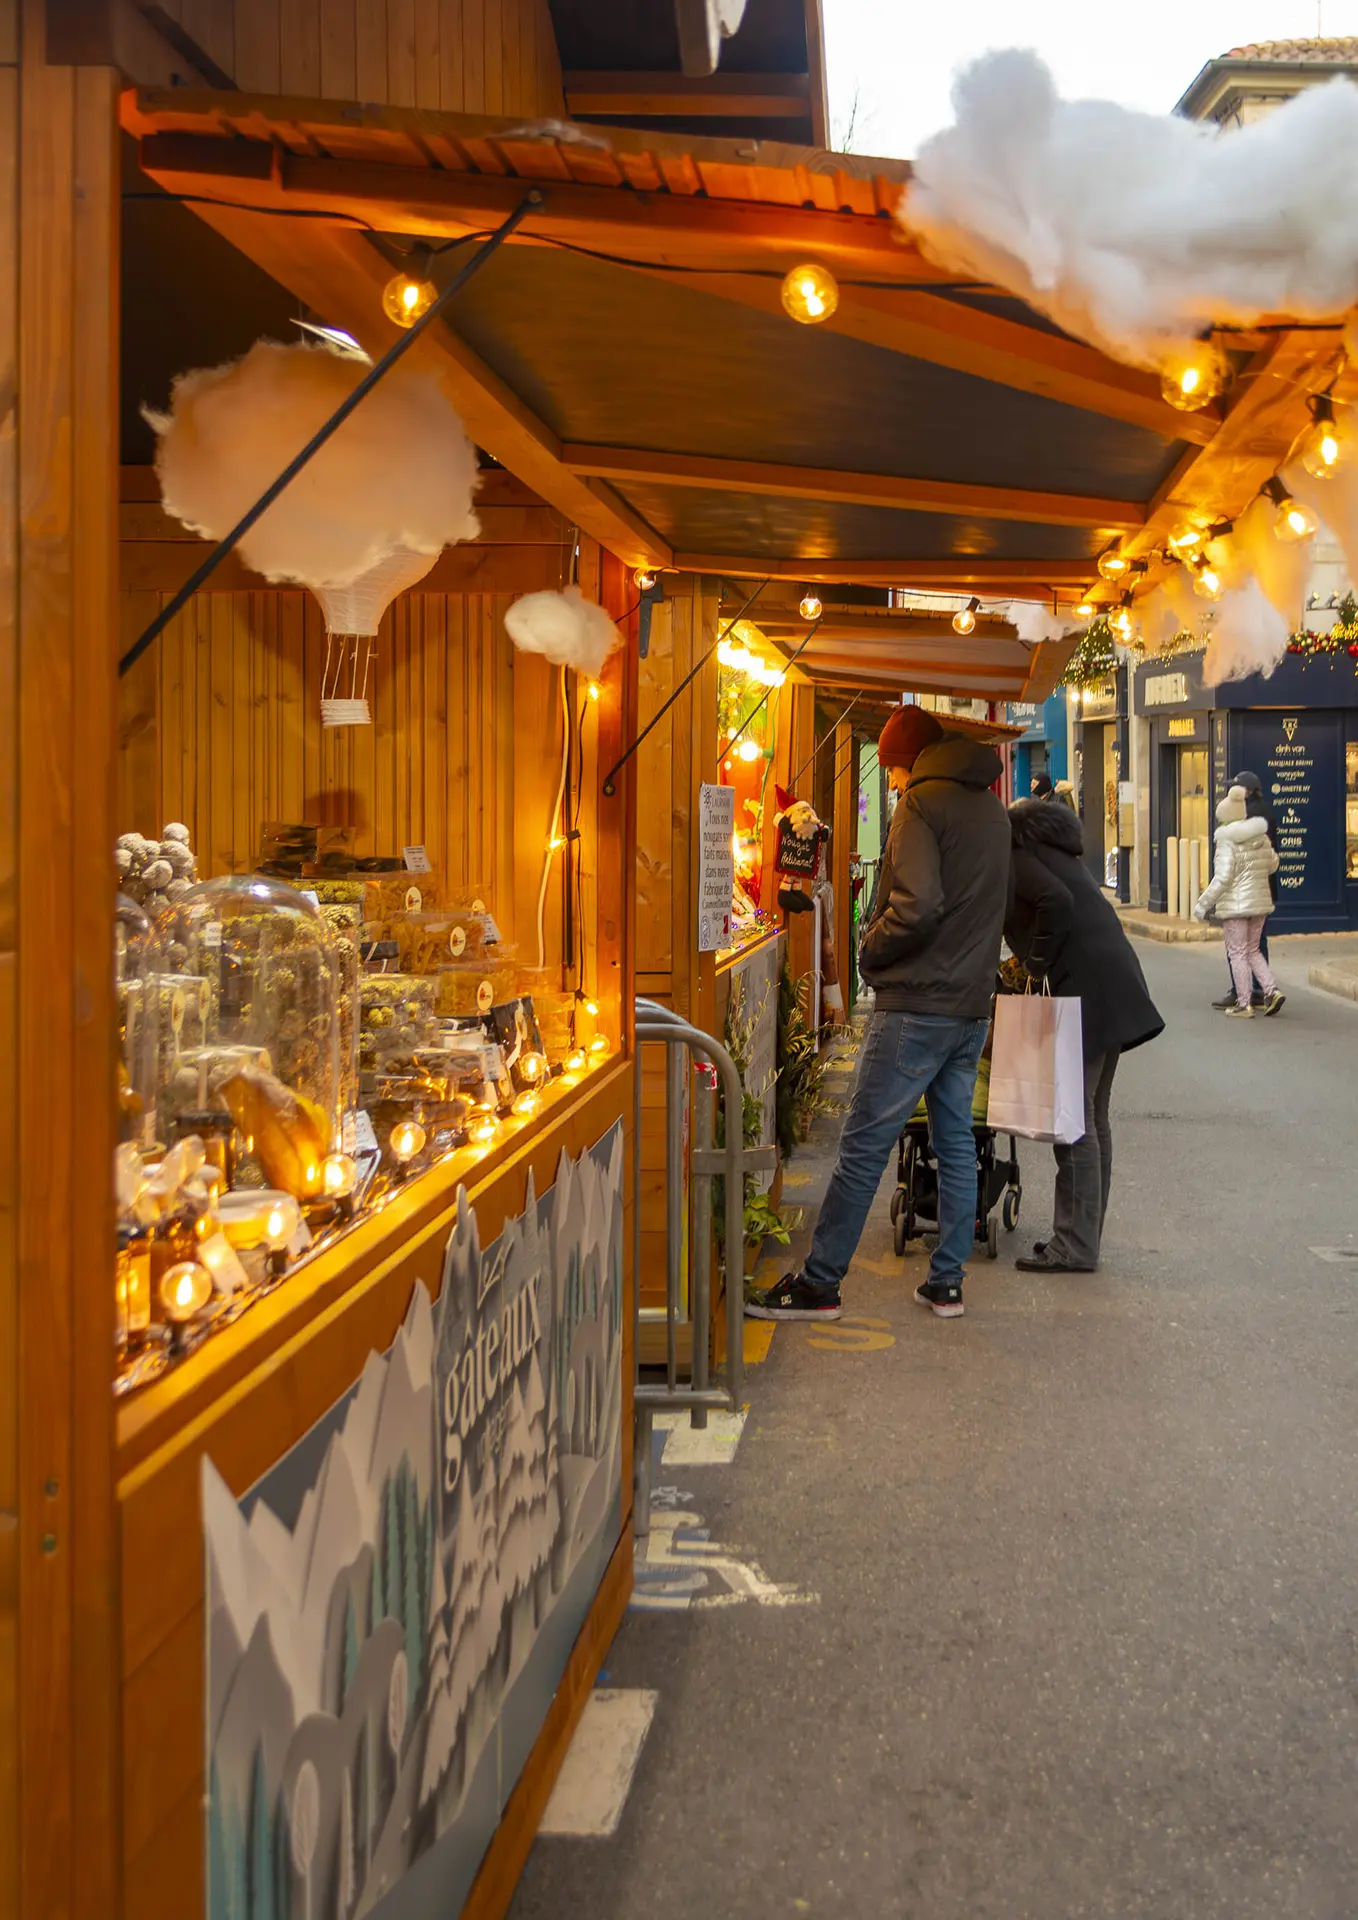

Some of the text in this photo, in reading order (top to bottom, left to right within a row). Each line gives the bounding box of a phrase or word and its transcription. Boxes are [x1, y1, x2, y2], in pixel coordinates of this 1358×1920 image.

[708, 810, 729, 824] Tous nos
[703, 832, 722, 846] nougats
[781, 835, 811, 857] Nougat
[703, 846, 715, 860] faits
[705, 863, 730, 878] dans notre
[703, 881, 730, 899] fabrique de
[443, 1268, 542, 1493] gâteaux
